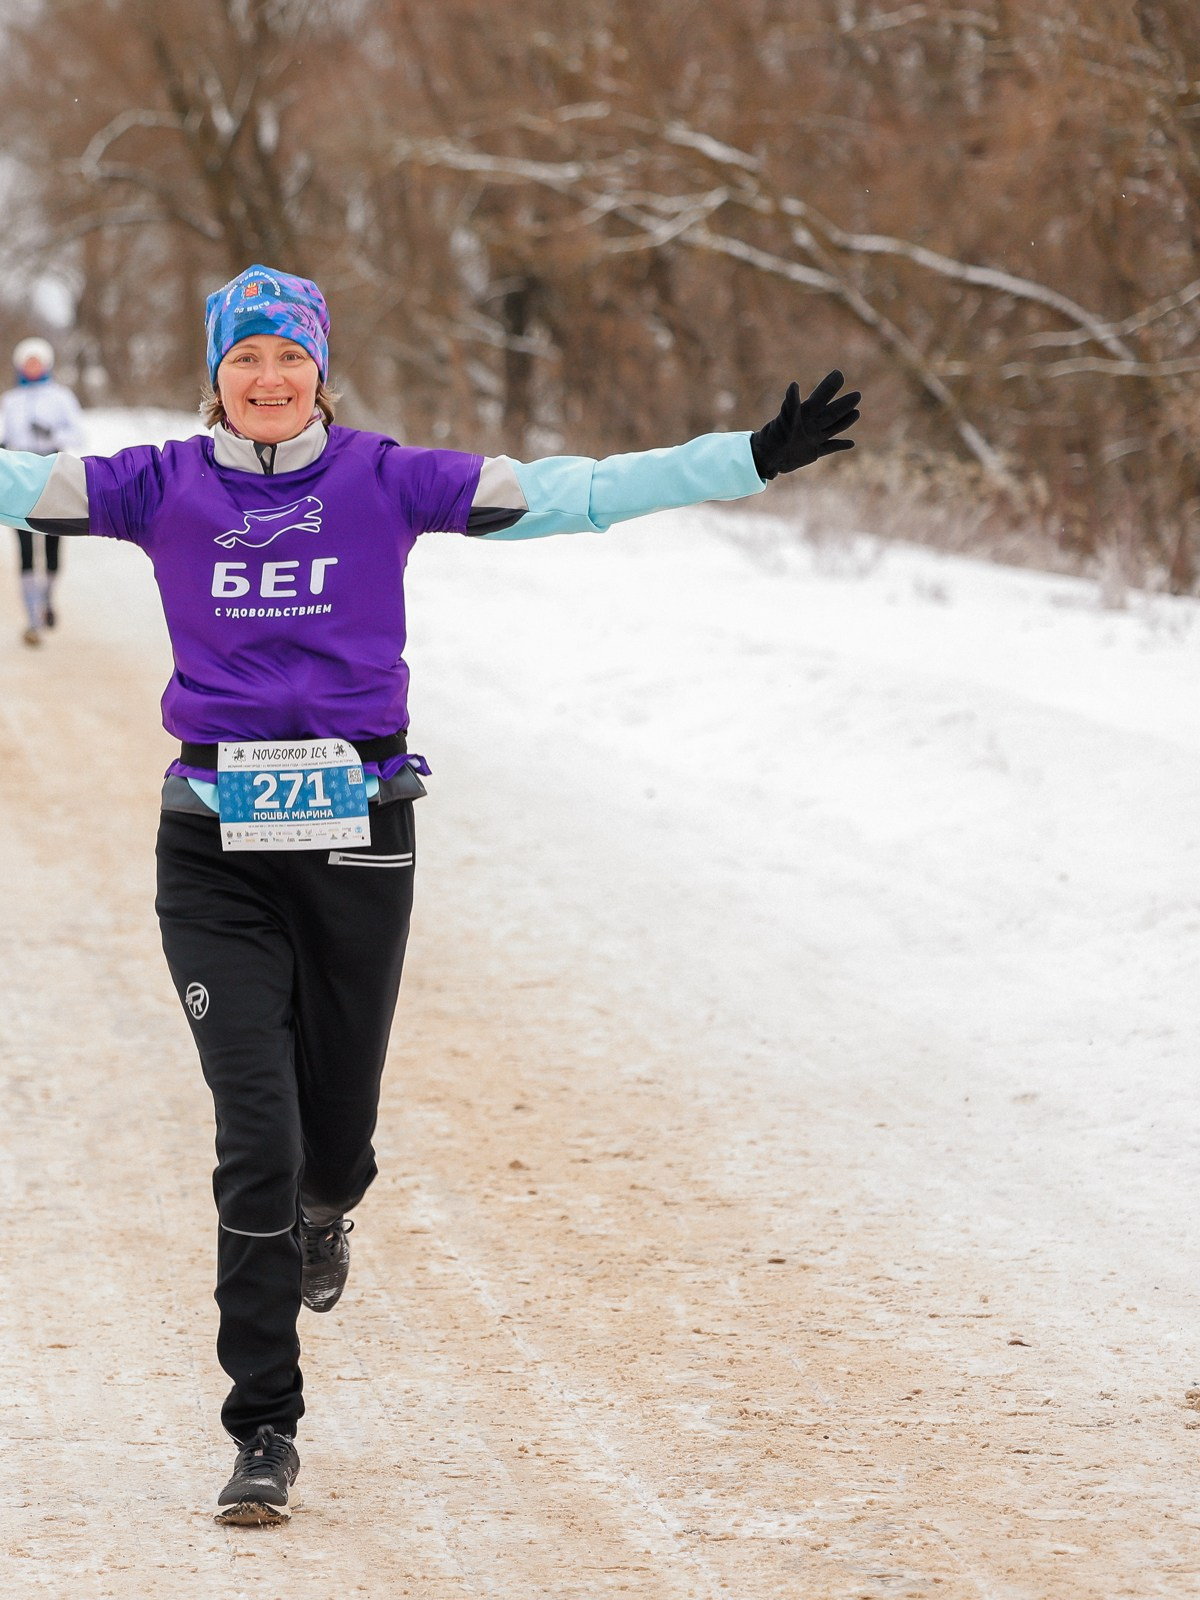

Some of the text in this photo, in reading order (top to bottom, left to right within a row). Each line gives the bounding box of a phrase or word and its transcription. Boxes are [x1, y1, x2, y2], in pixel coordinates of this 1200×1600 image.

[211, 556, 339, 598] БЕГ
[214, 603, 332, 619] С УДОВОЛЬСТВИЕМ
[251, 746, 328, 761] NOVGOROD ICE
[252, 771, 332, 809] 271
[253, 809, 334, 821] ПОШВА МАРИНА
